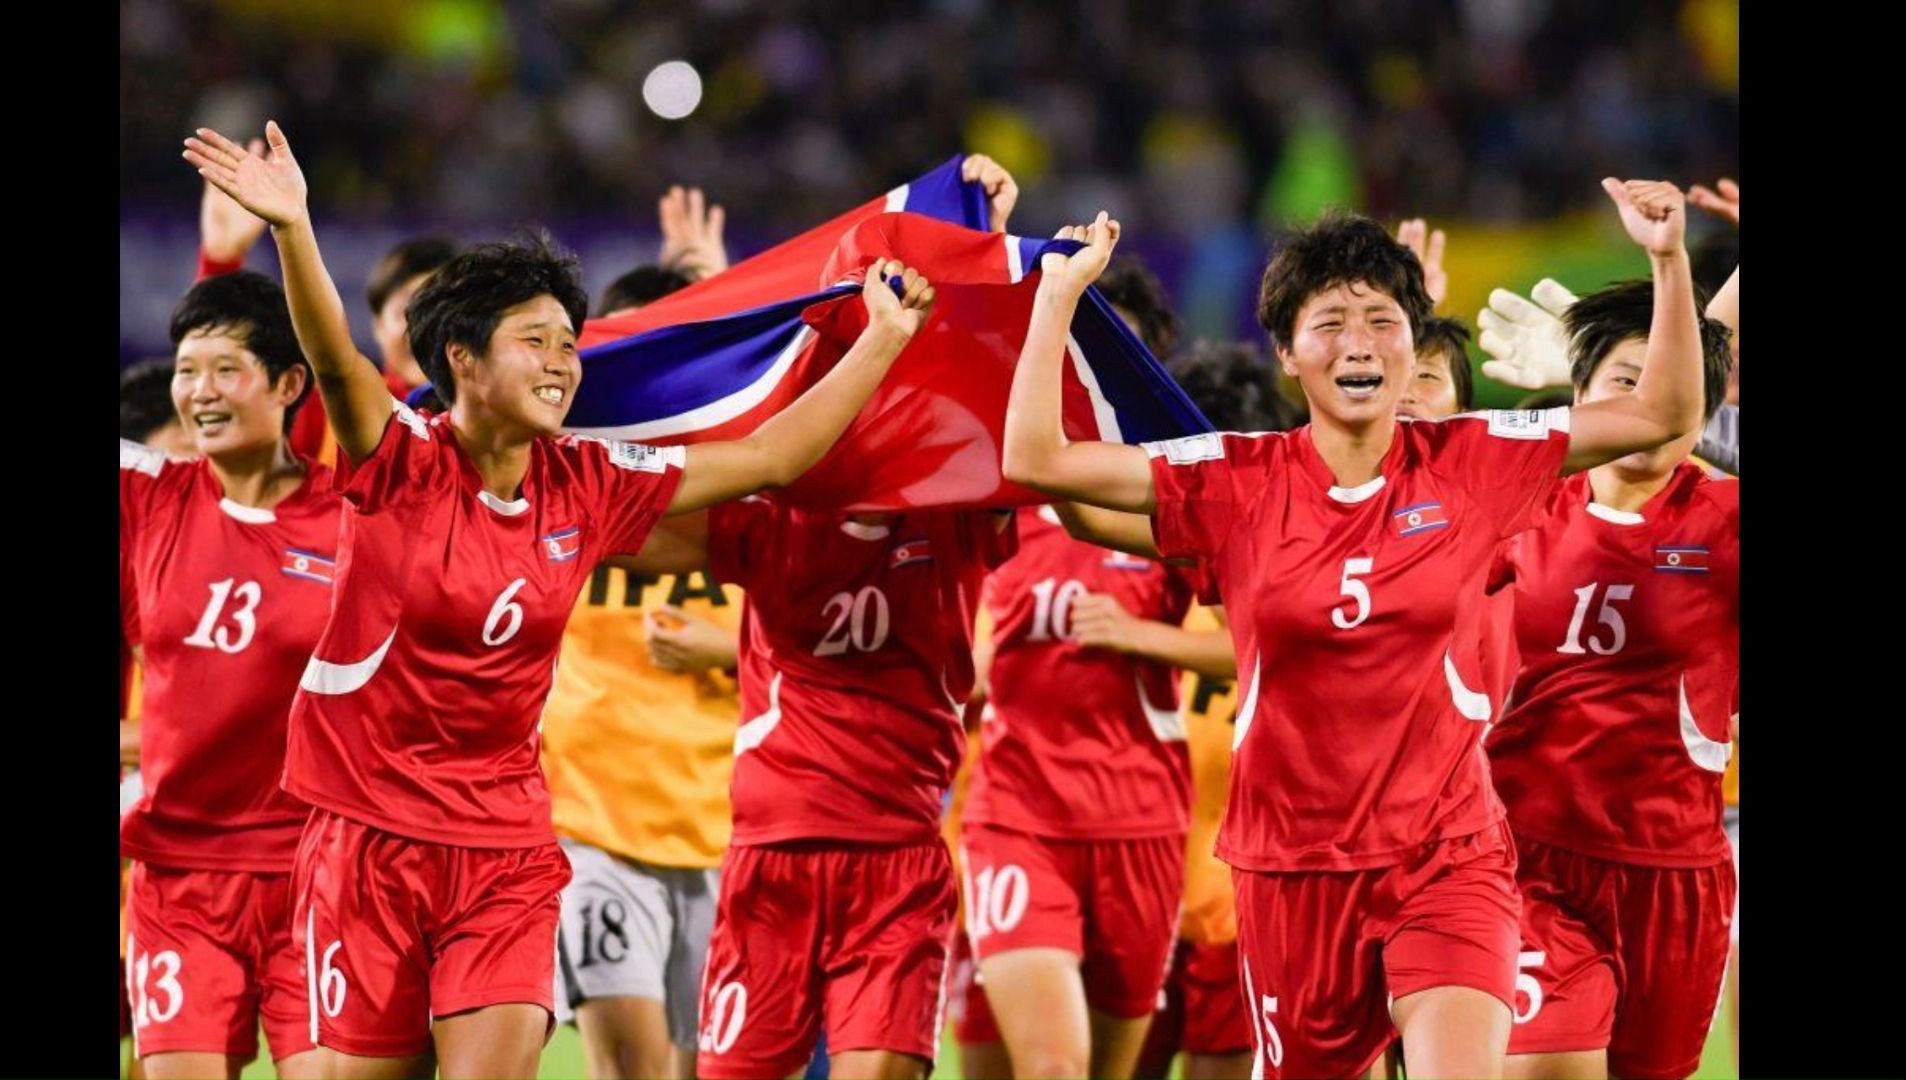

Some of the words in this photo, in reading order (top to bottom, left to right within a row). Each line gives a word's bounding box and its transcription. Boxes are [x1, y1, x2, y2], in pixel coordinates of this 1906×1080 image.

[184, 580, 260, 653] 13
[481, 578, 525, 646] 6
[588, 566, 729, 606] IFA
[812, 586, 889, 656] 20
[1025, 577, 1090, 642] 10
[1332, 557, 1372, 629] 5
[1558, 582, 1635, 656] 15
[578, 896, 630, 967] 18
[974, 864, 1029, 938] 10
[135, 949, 182, 1028] 13
[319, 940, 346, 1017] 6
[1514, 949, 1547, 1025] 5
[1262, 995, 1282, 1065] 5
